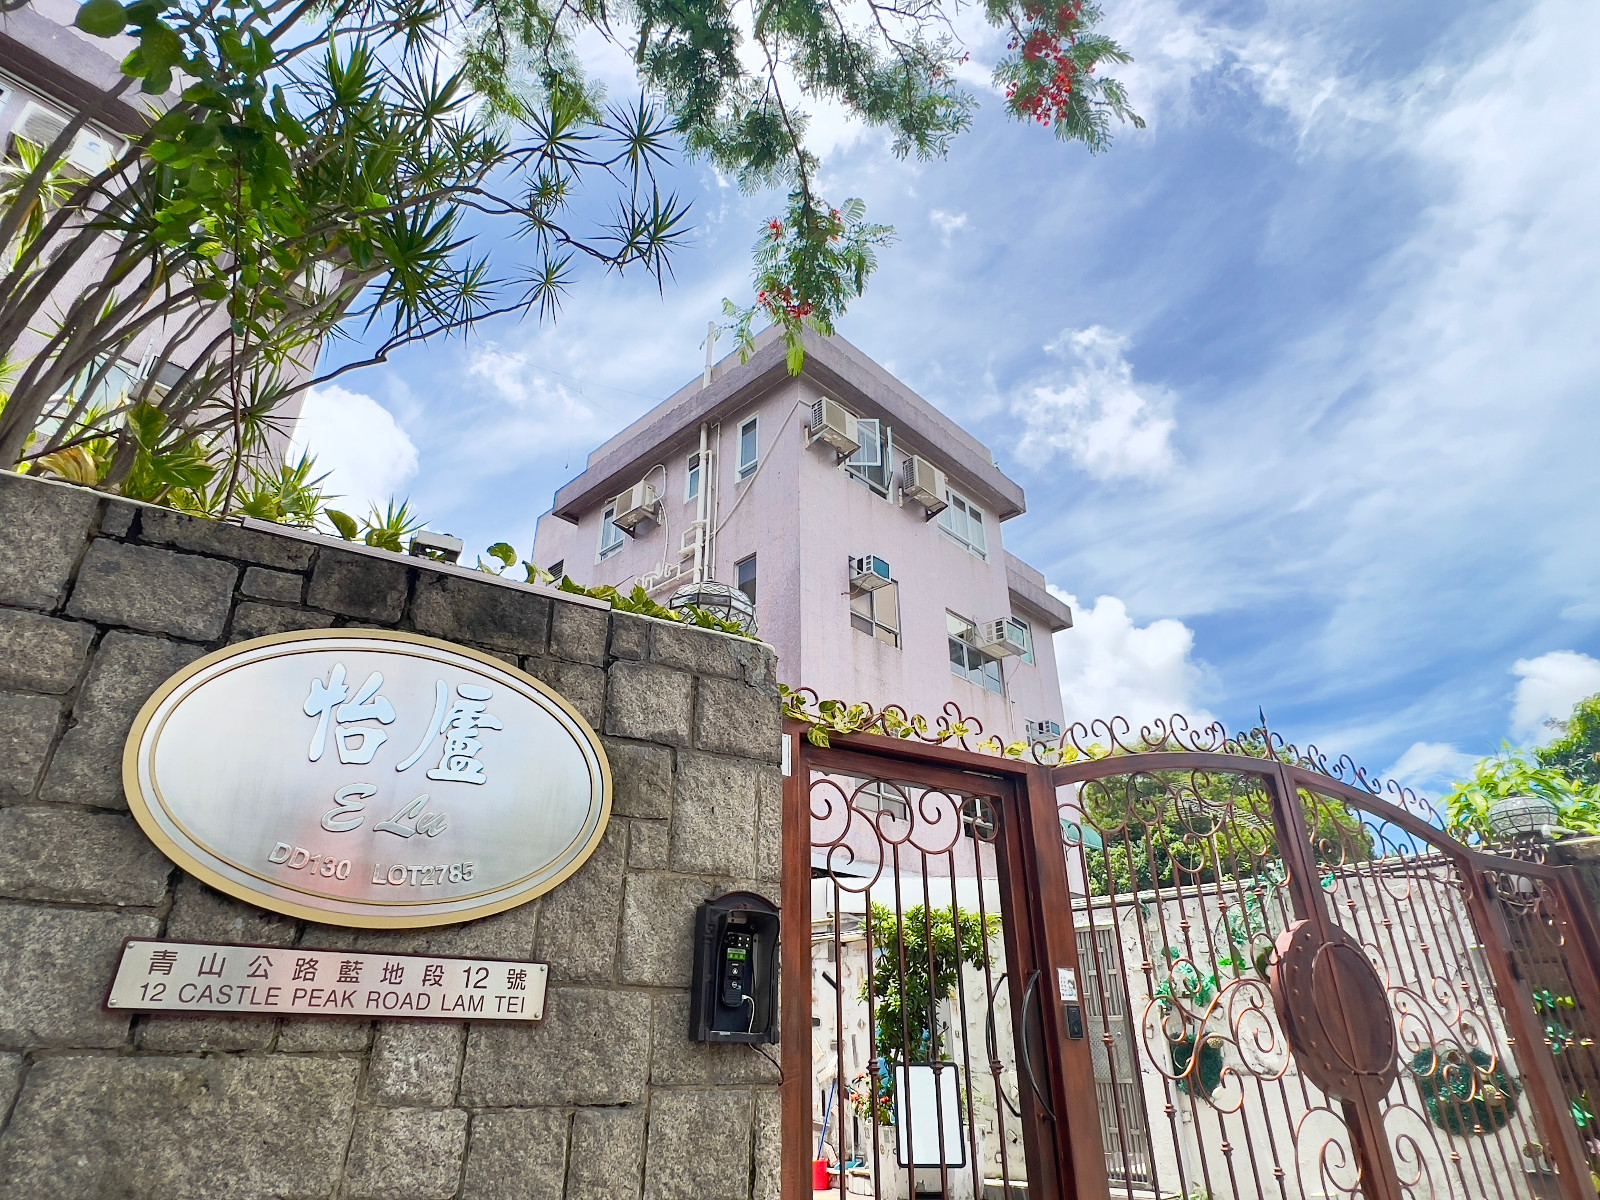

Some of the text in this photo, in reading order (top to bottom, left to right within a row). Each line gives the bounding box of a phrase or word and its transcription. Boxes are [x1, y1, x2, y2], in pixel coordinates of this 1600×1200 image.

[320, 783, 448, 838] E Lu
[267, 841, 475, 886] DD130 LOT2785
[148, 949, 528, 991] 青山公路藍地段12號
[140, 982, 526, 1014] 12 CASTLE PEAK ROAD LAM TEI
